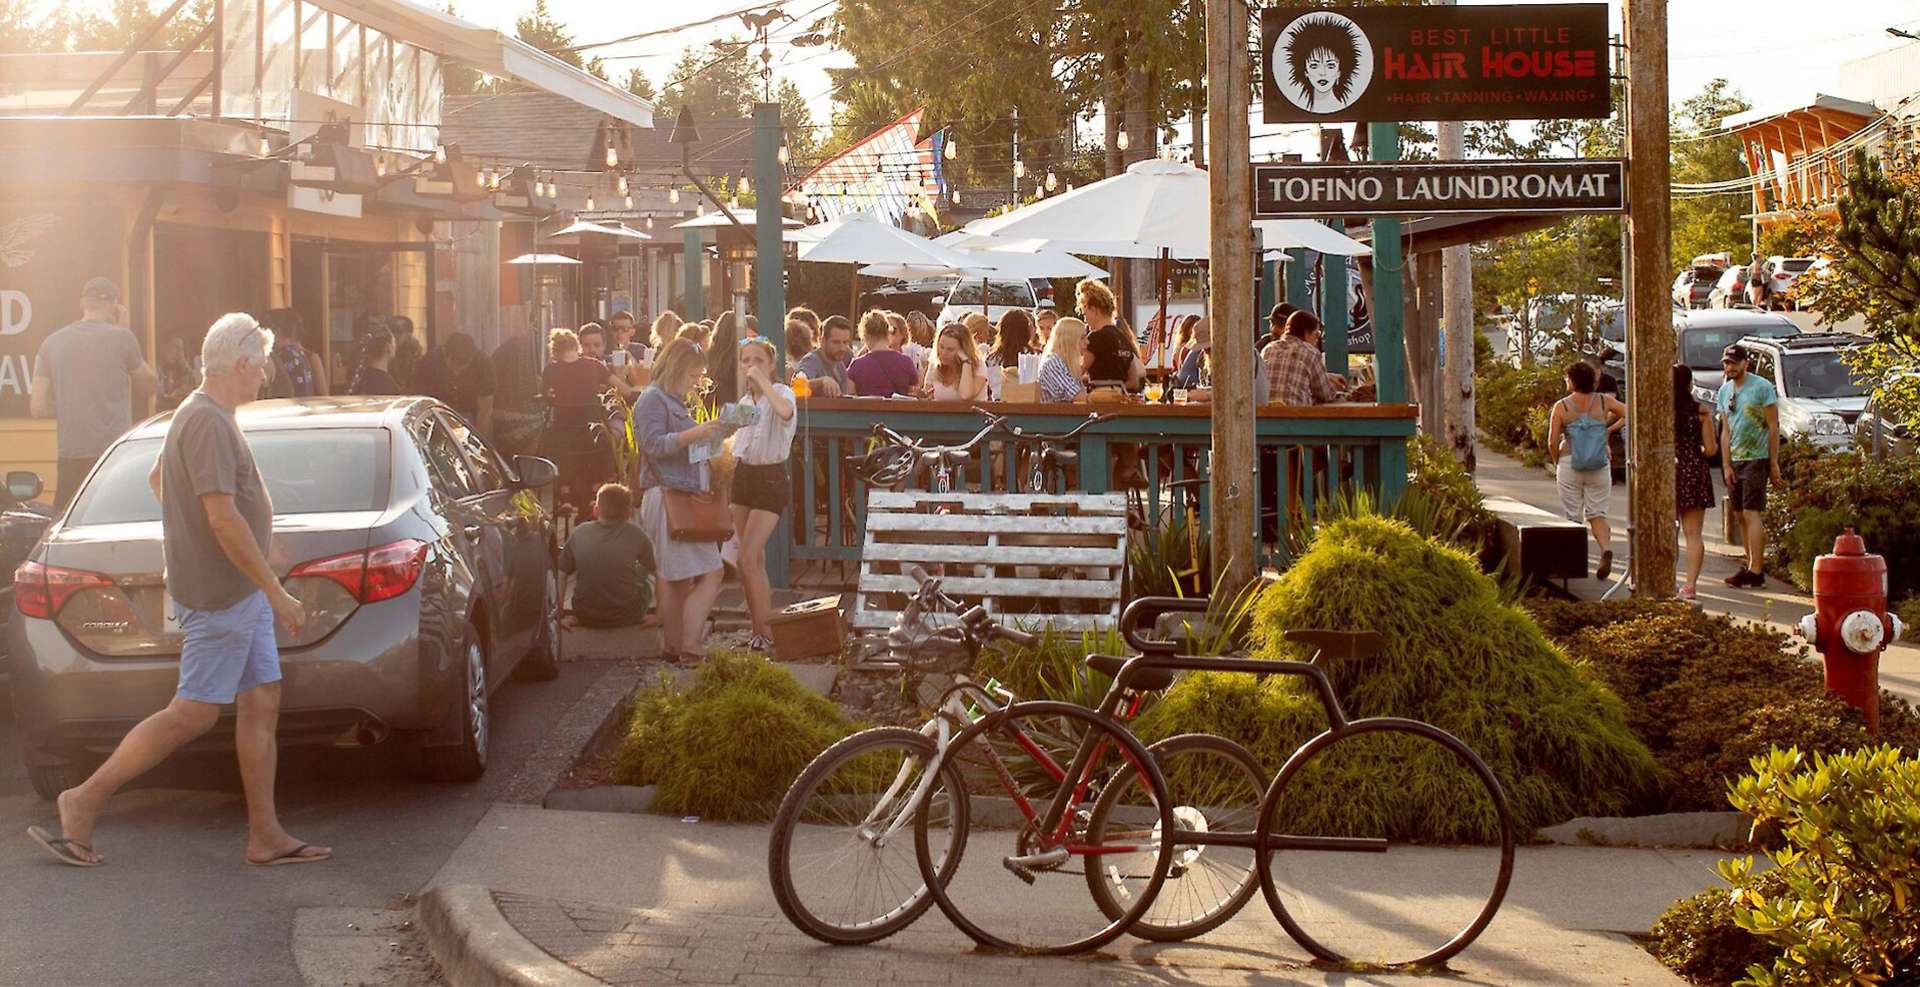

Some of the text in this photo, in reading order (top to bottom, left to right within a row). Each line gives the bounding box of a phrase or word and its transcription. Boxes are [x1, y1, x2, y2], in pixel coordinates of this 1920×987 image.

[1411, 27, 1569, 46] BEST LITTLE
[1482, 45, 1597, 79] HOUSE
[1268, 173, 1611, 202] TOFINO LAUNDROMAT
